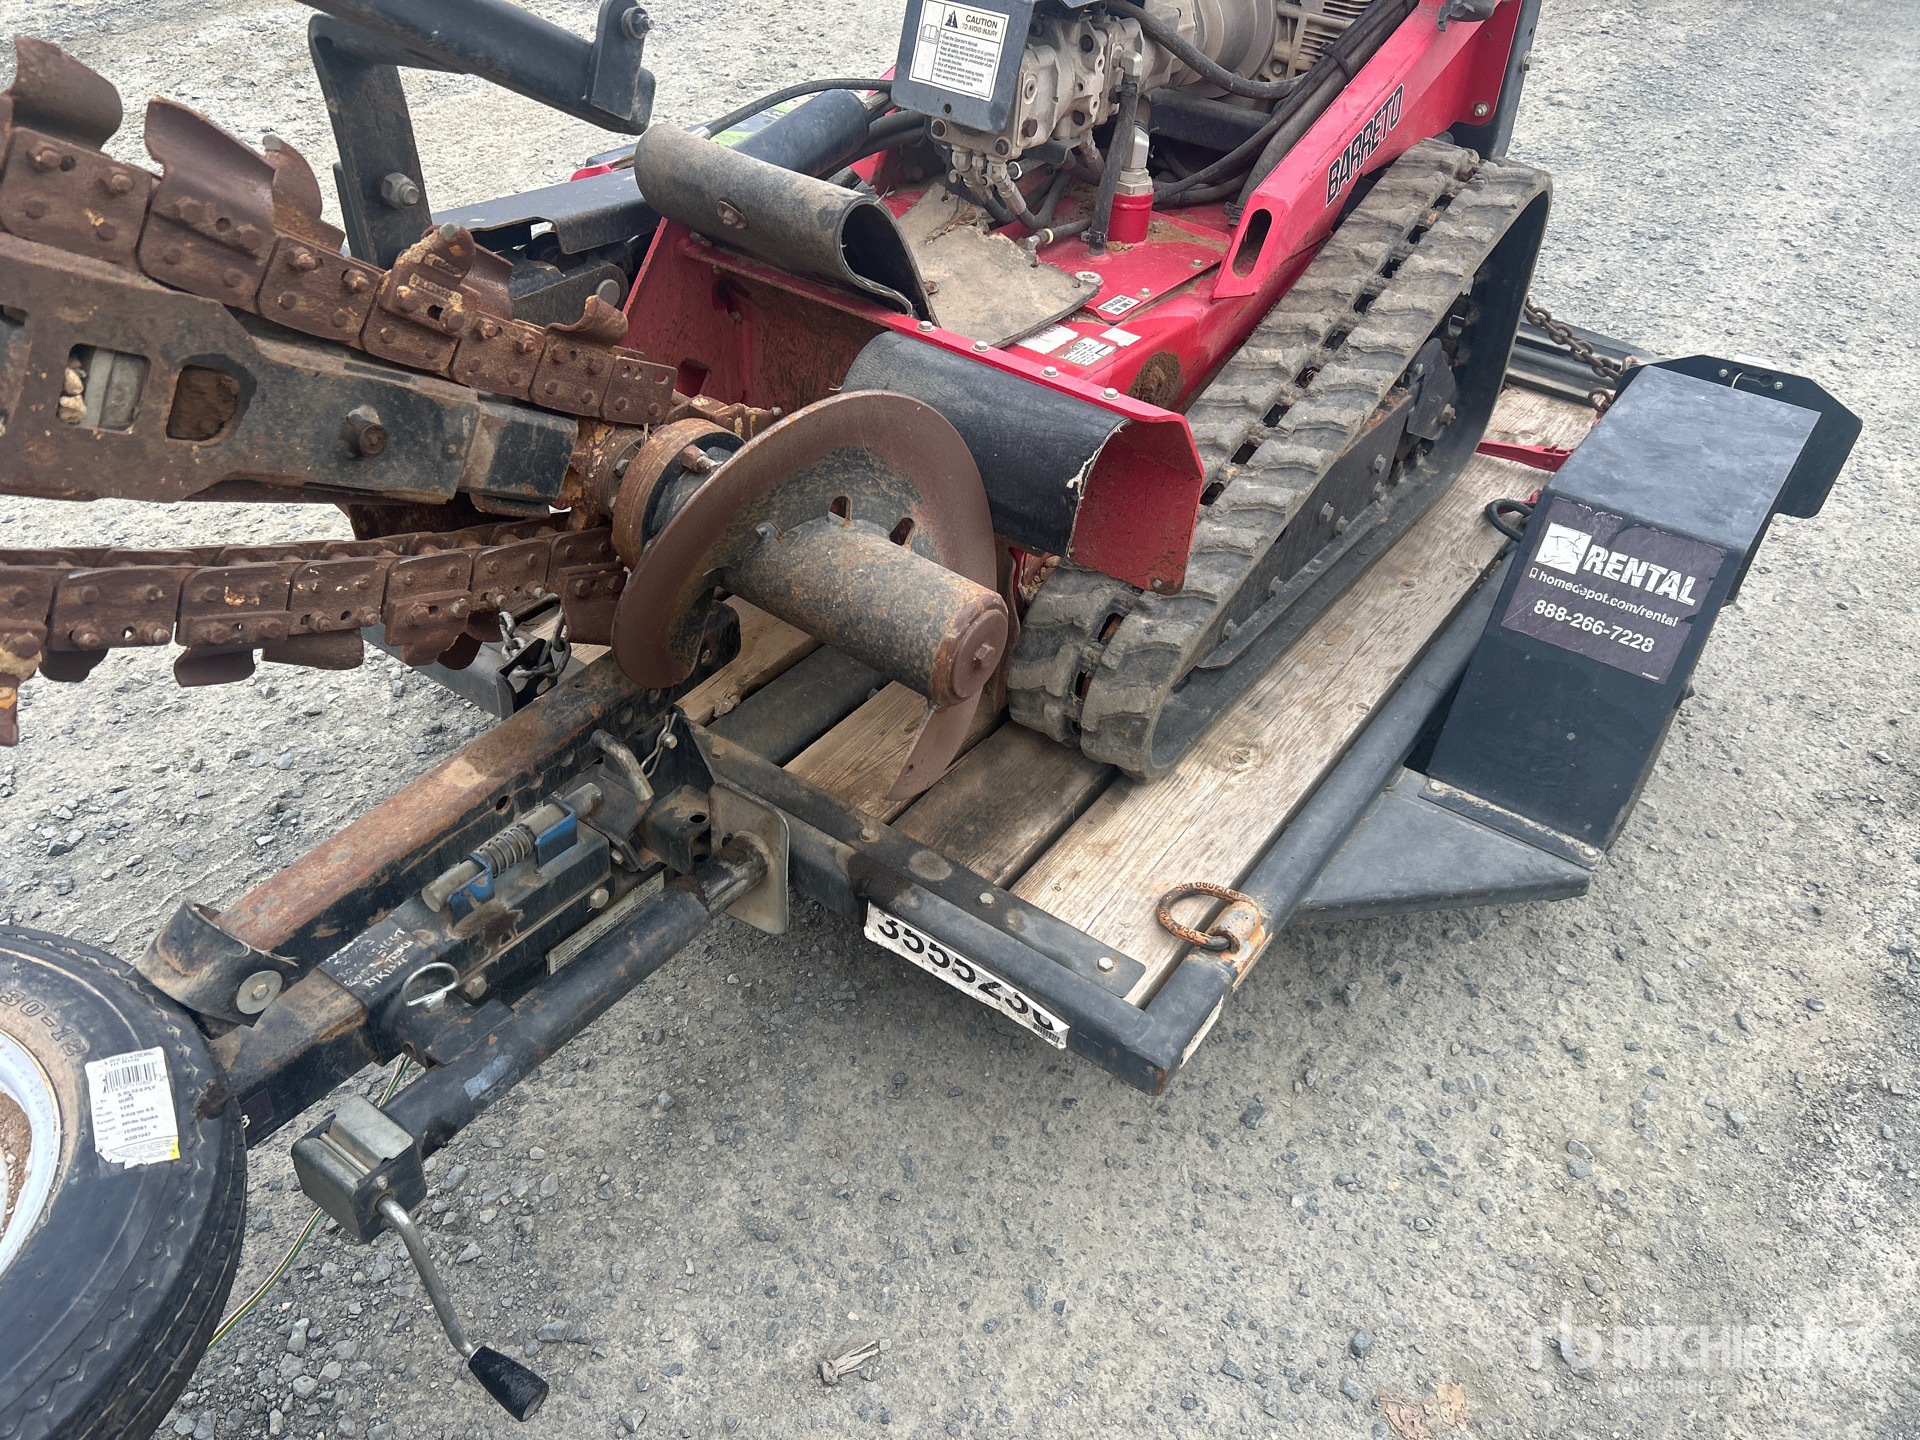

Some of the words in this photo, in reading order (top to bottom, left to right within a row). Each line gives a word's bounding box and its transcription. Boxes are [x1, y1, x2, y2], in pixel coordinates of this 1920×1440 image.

[966, 14, 998, 29] CAUTION
[969, 24, 982, 34] AVOID
[982, 28, 999, 37] INJURY
[1326, 83, 1404, 207] BARRETO
[1537, 570, 1679, 627] homedepot.com/rental
[1583, 544, 1697, 606] RENTAL
[1533, 599, 1655, 653] 888-266-7228
